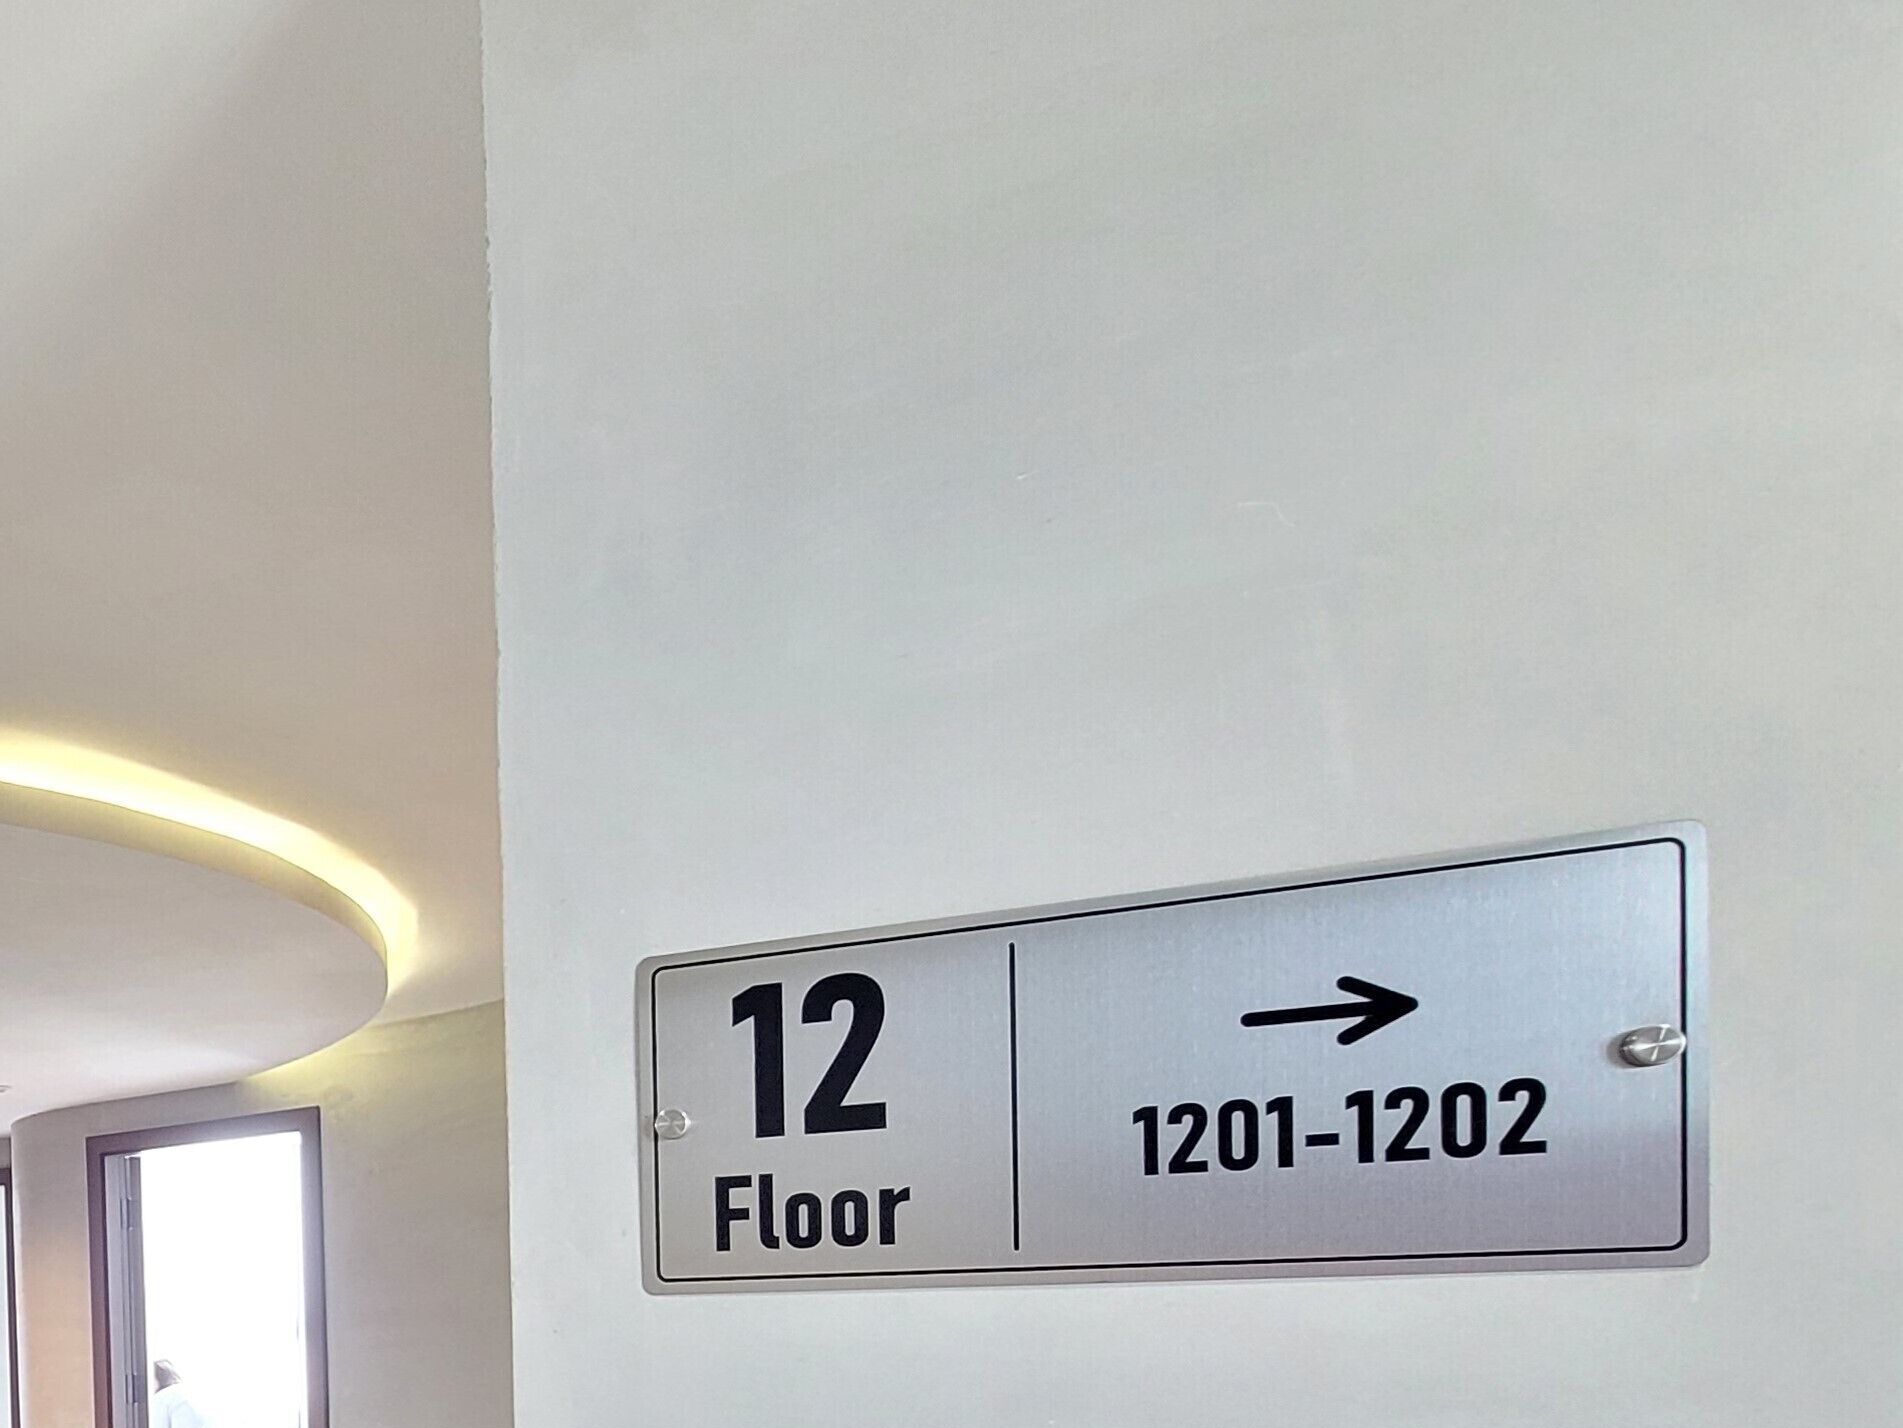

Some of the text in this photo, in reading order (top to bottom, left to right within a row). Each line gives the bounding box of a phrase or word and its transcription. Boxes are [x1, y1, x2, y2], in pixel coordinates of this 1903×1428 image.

[732, 973, 887, 1139] 12
[1132, 1077, 1548, 1176] 1201-1202
[714, 1174, 911, 1252] Floor
